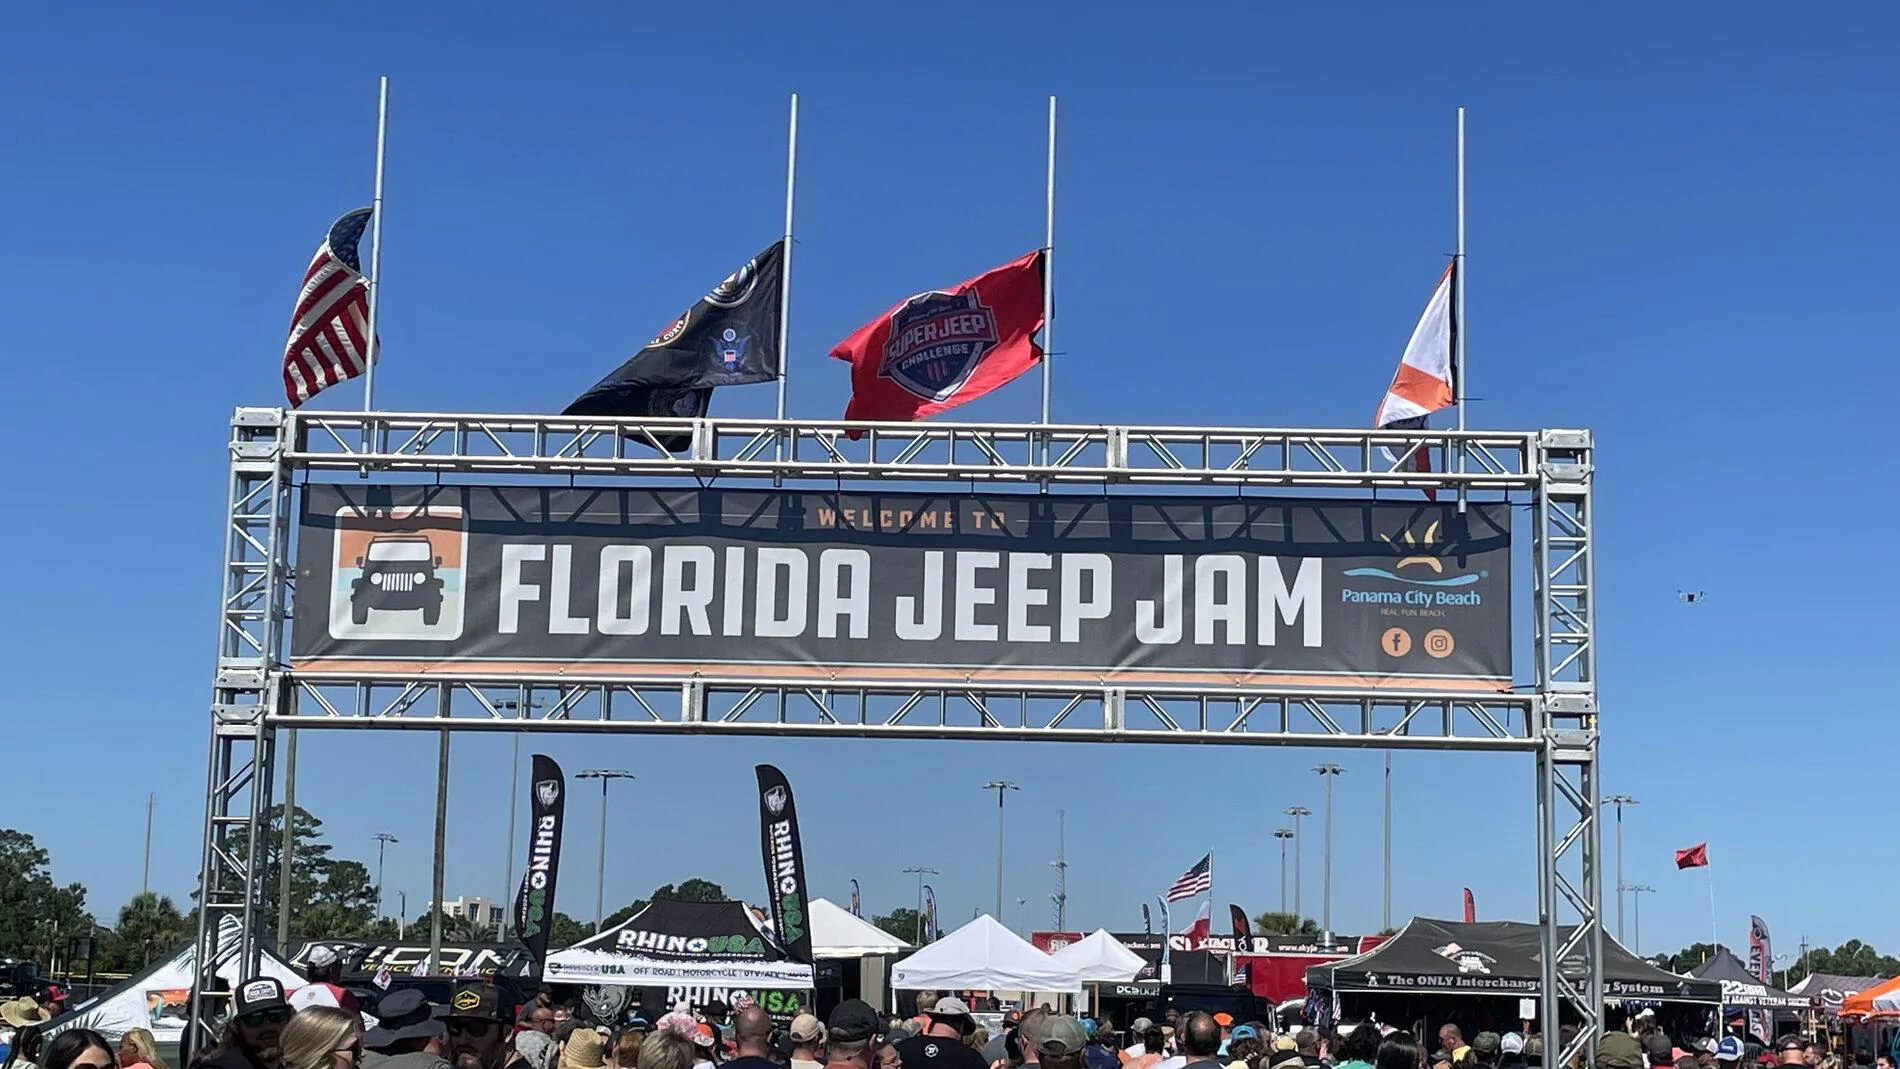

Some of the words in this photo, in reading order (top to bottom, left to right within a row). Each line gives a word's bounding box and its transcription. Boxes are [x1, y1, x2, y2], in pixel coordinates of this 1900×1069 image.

[889, 322, 937, 360] SUPER
[939, 314, 985, 339] JEEP
[901, 343, 969, 370] CHALLENGE
[818, 509, 953, 528] WELCOME
[972, 511, 1005, 529] TO
[498, 543, 871, 639] FLORIDA
[895, 550, 1112, 644] JEEP
[1134, 553, 1323, 648] JAM
[1342, 588, 1401, 604] Panama
[1405, 590, 1433, 608] City
[1436, 590, 1481, 605] Beach
[633, 967, 649, 975] OFF
[652, 967, 675, 976] ROAD
[683, 968, 737, 977] MOTORCYCLE
[1117, 985, 1139, 995] DCS
[1387, 975, 1414, 985] The
[1417, 975, 1453, 986] ONLY
[1613, 981, 1664, 995] System
